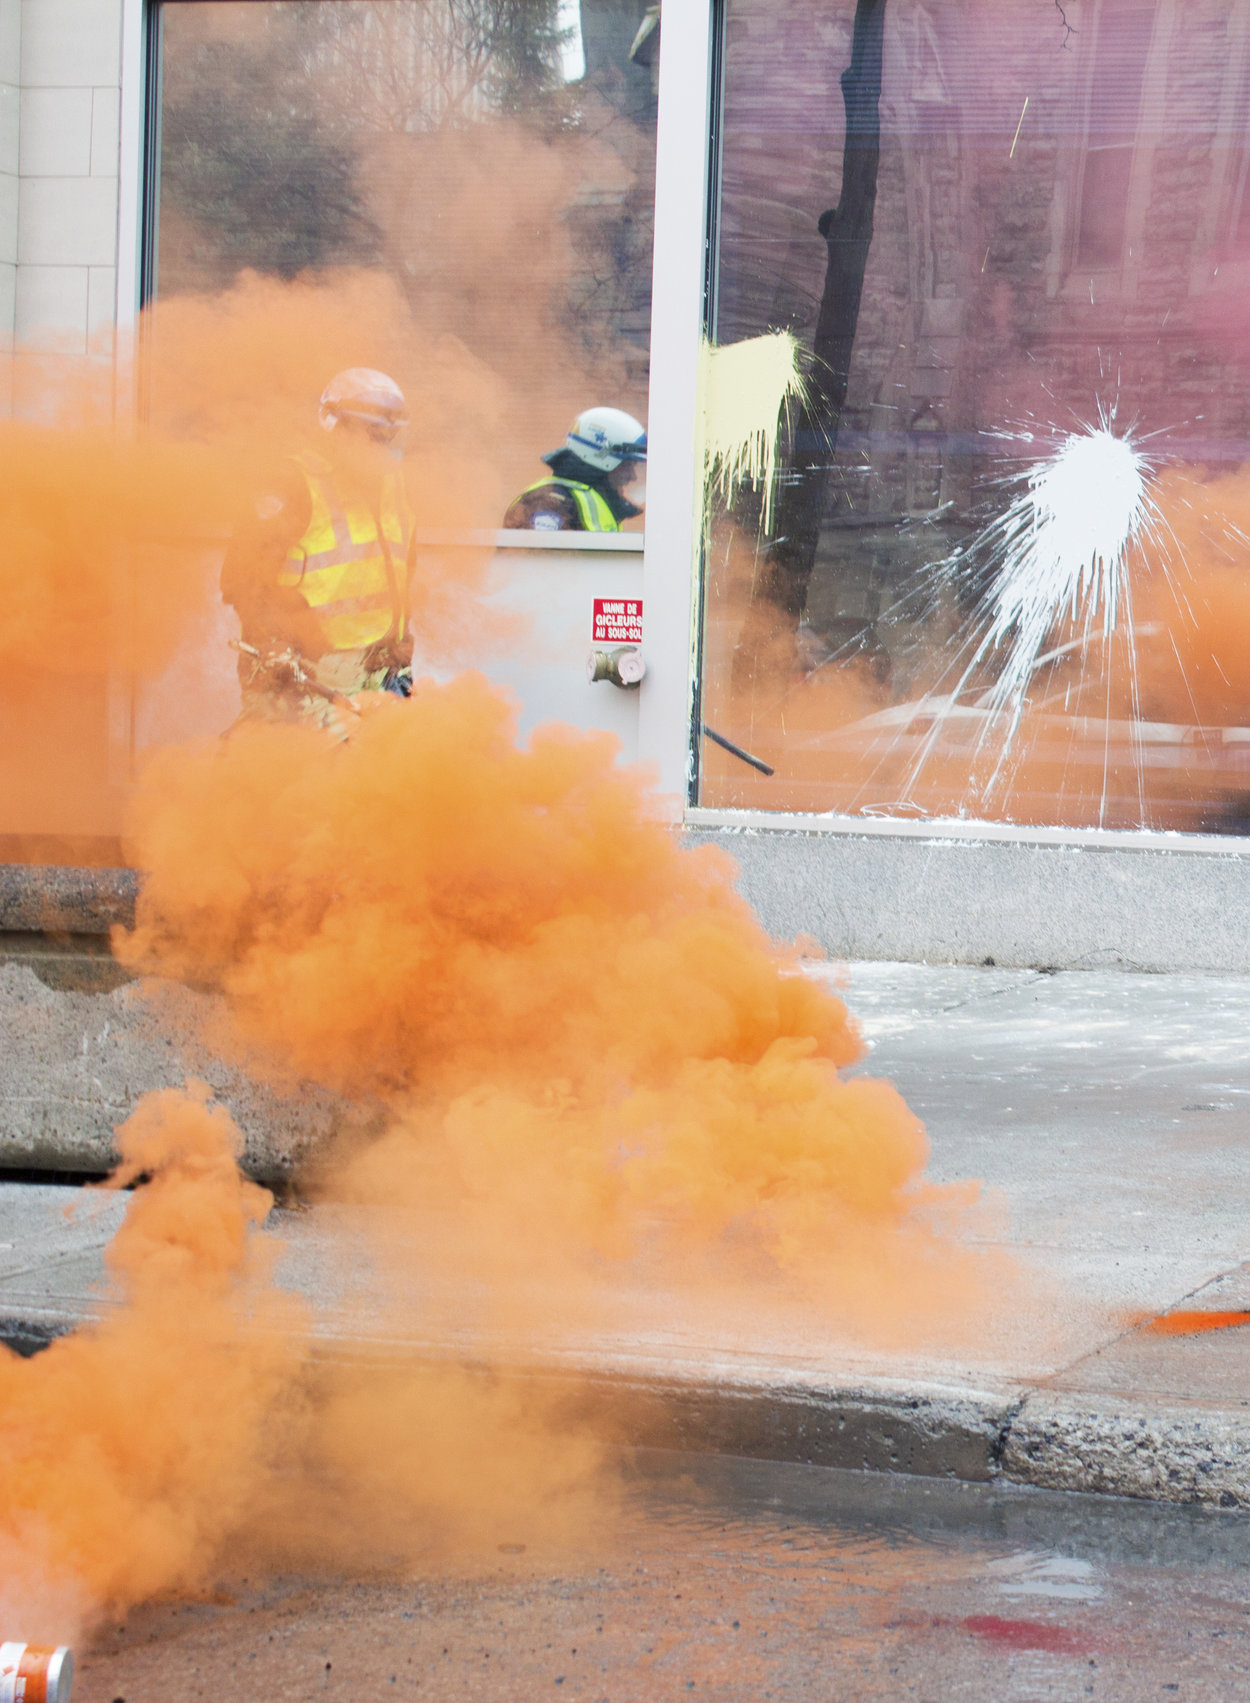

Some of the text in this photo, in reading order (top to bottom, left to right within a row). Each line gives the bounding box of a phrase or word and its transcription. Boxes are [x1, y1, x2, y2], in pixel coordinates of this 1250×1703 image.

[602, 602, 637, 615] VANNE DE
[596, 614, 643, 627] GICLEURS
[595, 627, 606, 639] AU
